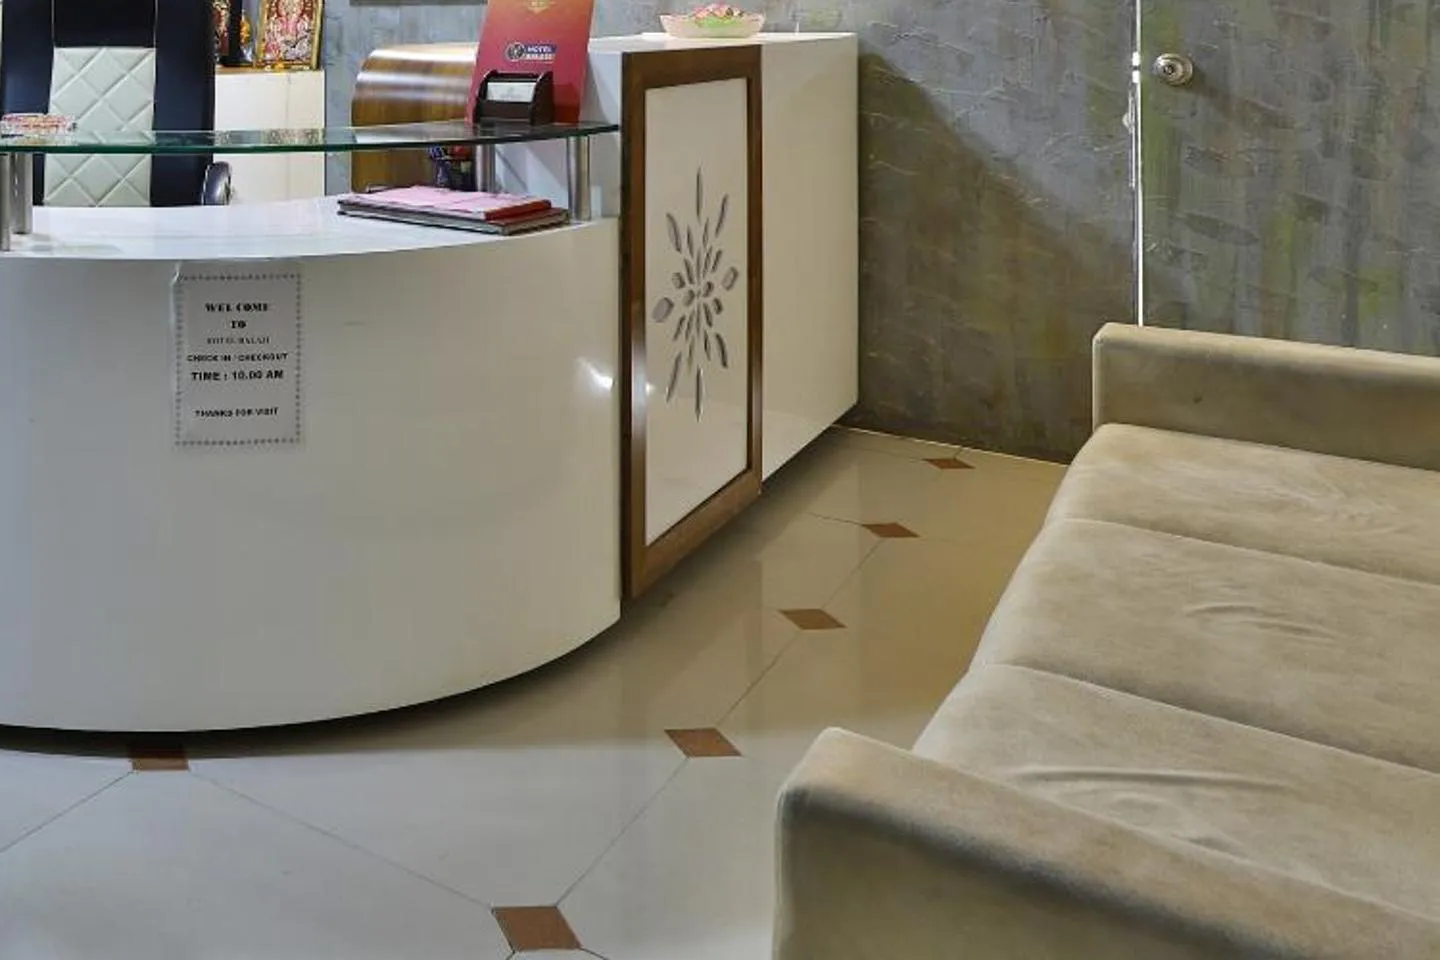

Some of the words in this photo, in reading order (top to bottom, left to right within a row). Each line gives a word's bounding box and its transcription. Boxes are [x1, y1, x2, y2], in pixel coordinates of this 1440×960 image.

[231, 320, 246, 329] TO
[191, 371, 221, 381] TIME
[266, 370, 284, 379] AM
[195, 409, 233, 418] THANKS
[236, 408, 253, 417] FOR
